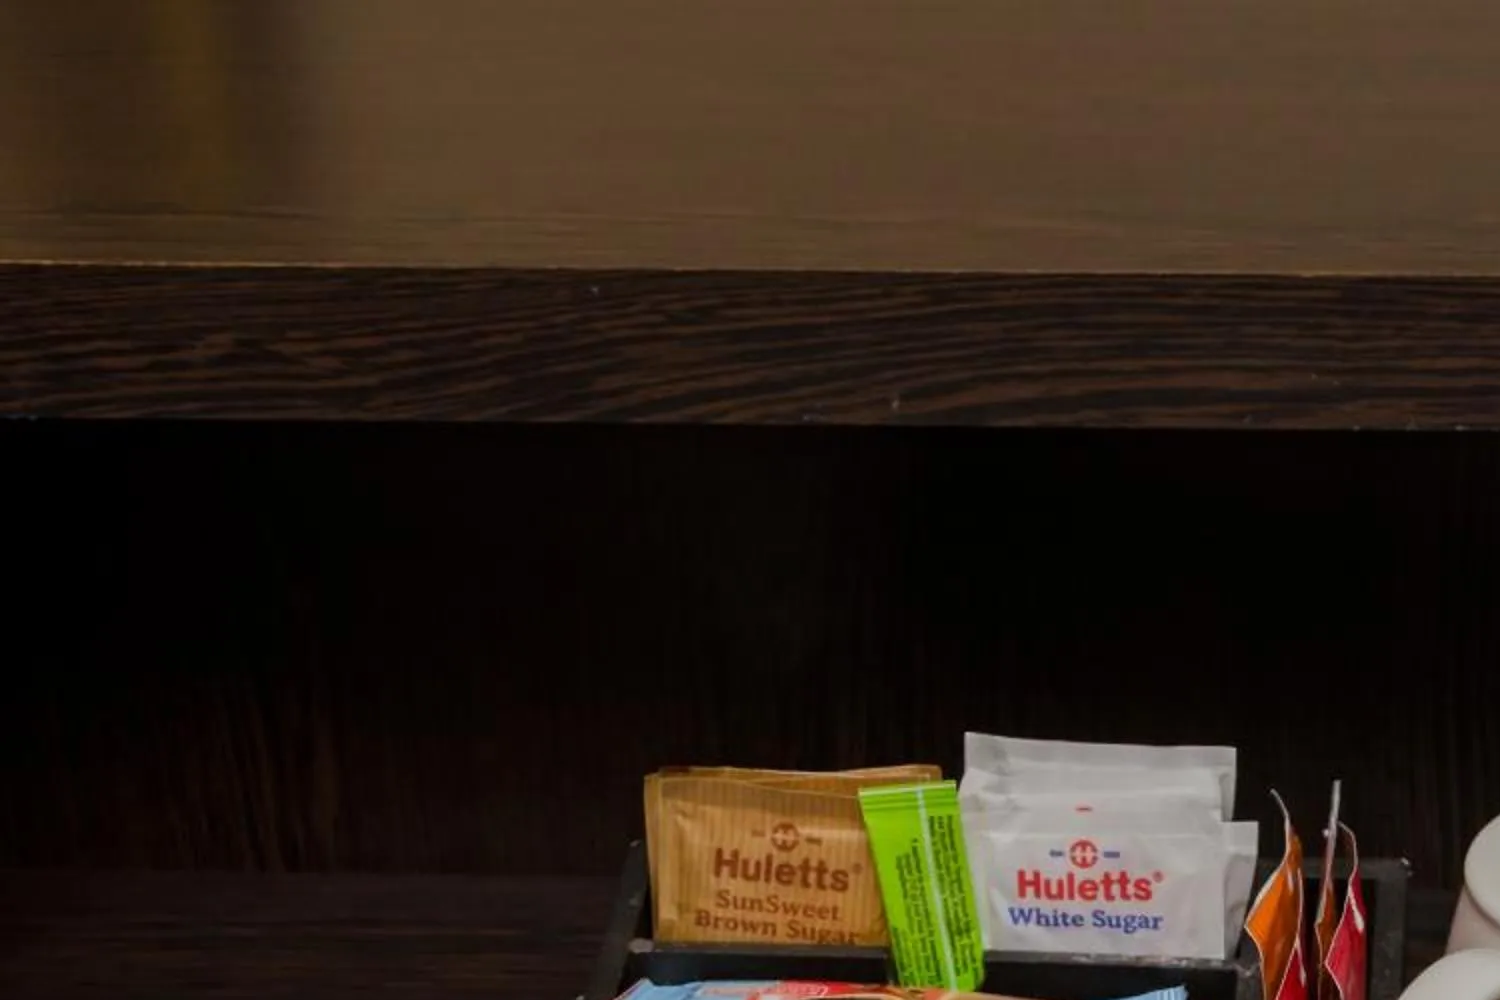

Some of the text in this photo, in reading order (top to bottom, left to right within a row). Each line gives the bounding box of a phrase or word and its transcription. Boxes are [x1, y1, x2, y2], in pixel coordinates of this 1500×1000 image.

[713, 848, 849, 892] Huletts
[1016, 869, 1153, 901] Huletts
[715, 889, 839, 921] SunSweet
[1008, 907, 1164, 934] White Sugar
[694, 908, 778, 937] Brown
